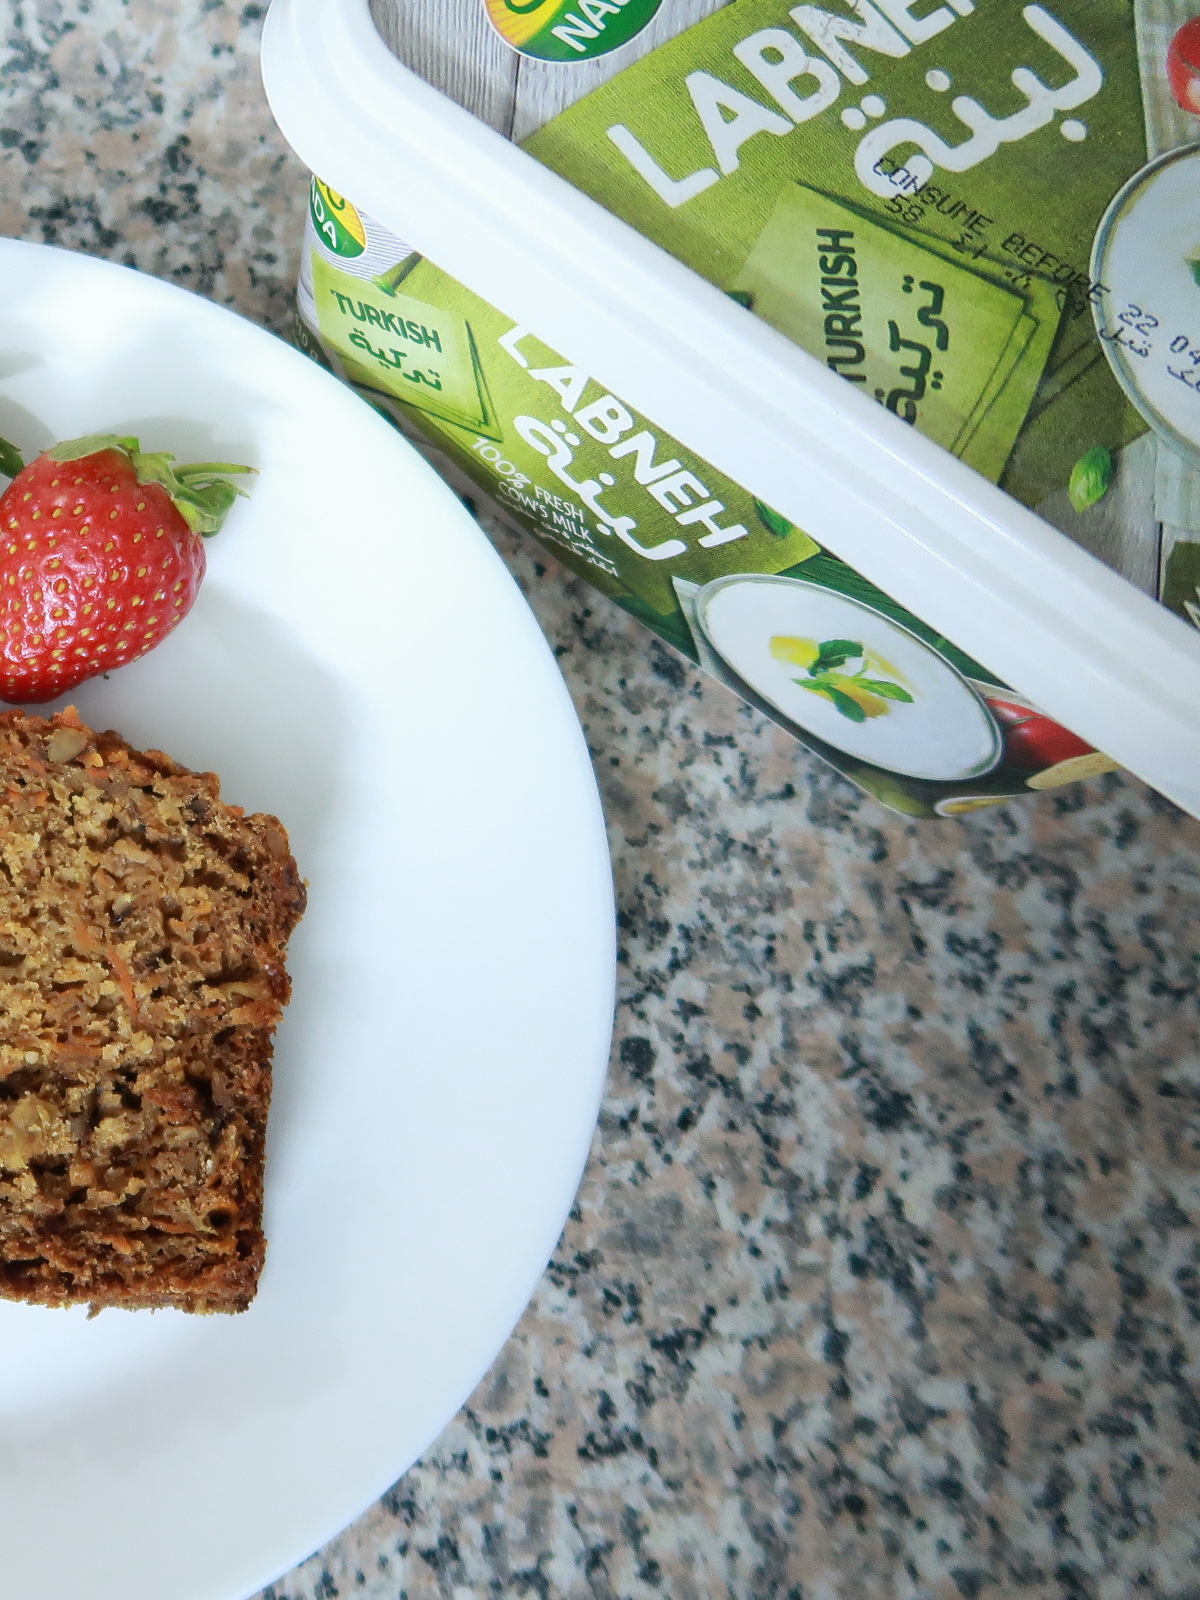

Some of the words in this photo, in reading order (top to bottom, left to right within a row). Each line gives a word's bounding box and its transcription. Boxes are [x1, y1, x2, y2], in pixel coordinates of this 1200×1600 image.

[551, 0, 632, 53] NA
[841, 4, 1102, 199] لبنة
[607, 0, 976, 209] LABNE
[330, 289, 442, 353] TURKISH
[816, 228, 867, 383] TURKISH
[873, 157, 994, 236] CONSUME
[1000, 232, 1110, 305] BEFORE
[1117, 303, 1159, 336] 22
[472, 437, 532, 489] 100%
[534, 485, 585, 524] FRESH
[497, 324, 749, 548] LABNEH
[513, 414, 687, 560] لبنة
[498, 481, 548, 518] COW'S
[552, 511, 593, 544] MILK
